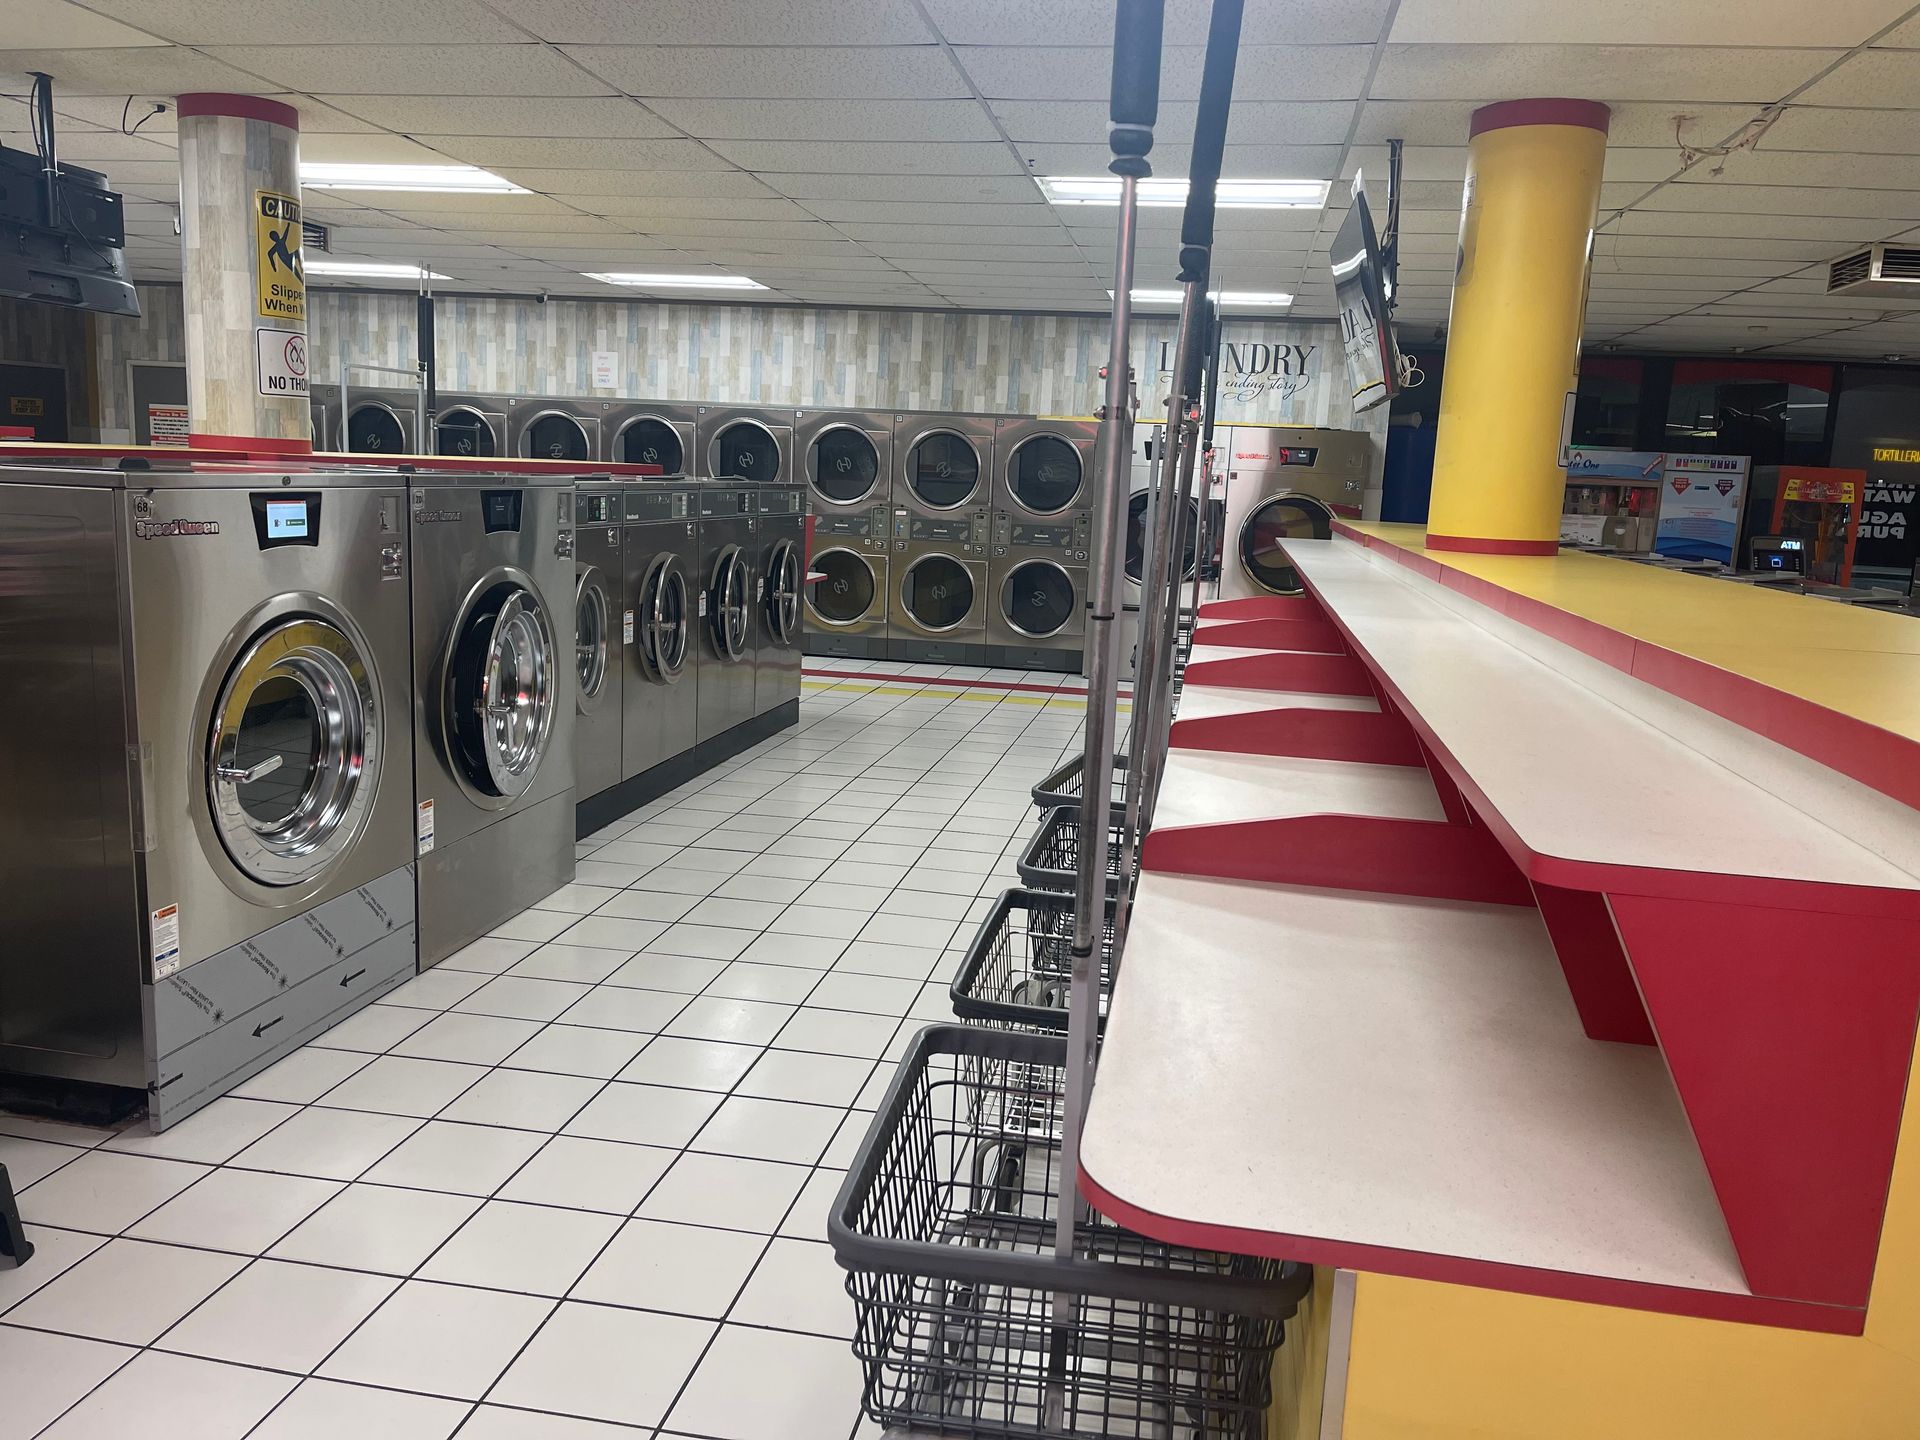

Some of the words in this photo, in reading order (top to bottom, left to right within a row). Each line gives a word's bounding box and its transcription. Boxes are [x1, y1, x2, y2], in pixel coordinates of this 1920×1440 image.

[265, 298, 298, 314] When
[1159, 342, 1317, 376] LNDRY
[268, 375, 286, 390] NO
[1223, 371, 1265, 402] ending
[1267, 374, 1310, 400] story
[1584, 459, 1599, 469] One
[137, 502, 148, 513] 68
[136, 520, 180, 540] Speed
[180, 519, 219, 535] Queen
[1780, 541, 1801, 550] ATM
